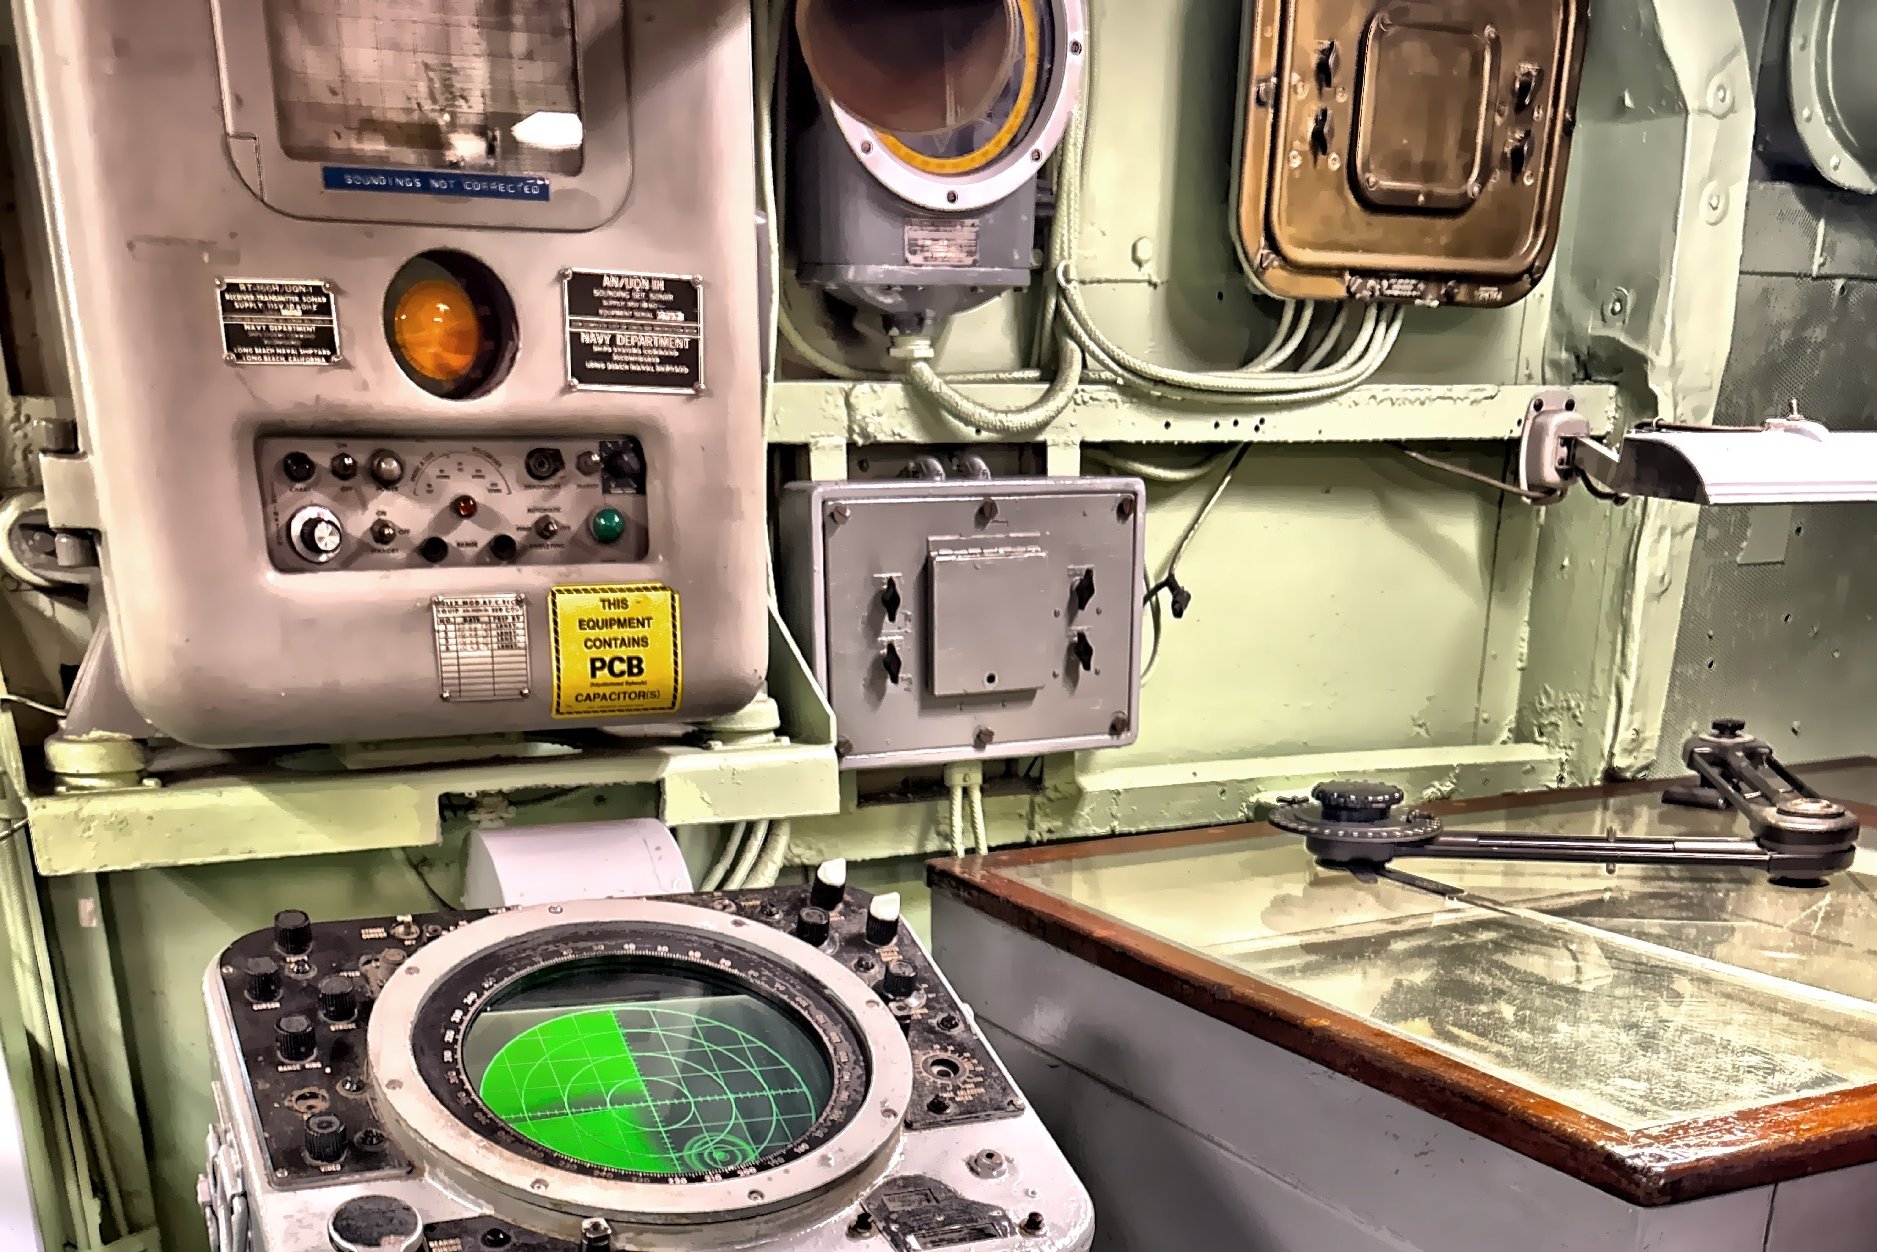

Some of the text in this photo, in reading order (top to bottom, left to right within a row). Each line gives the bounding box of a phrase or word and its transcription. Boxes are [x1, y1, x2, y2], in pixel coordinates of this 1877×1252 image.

[343, 174, 540, 194] SOUNDINGS NOT CORRECTED
[233, 301, 263, 309] SUPPLY
[243, 323, 317, 333] NAVY DEPARTMENT
[580, 332, 691, 350] NAVY DEPARTMENT
[599, 597, 630, 611] THIS
[578, 616, 654, 631] EQUIPMENT
[583, 635, 650, 650] CONTAINS
[589, 655, 645, 680] PCB
[574, 689, 661, 703] CAPACITOR(S)
[320, 1163, 341, 1173] VIDEO
